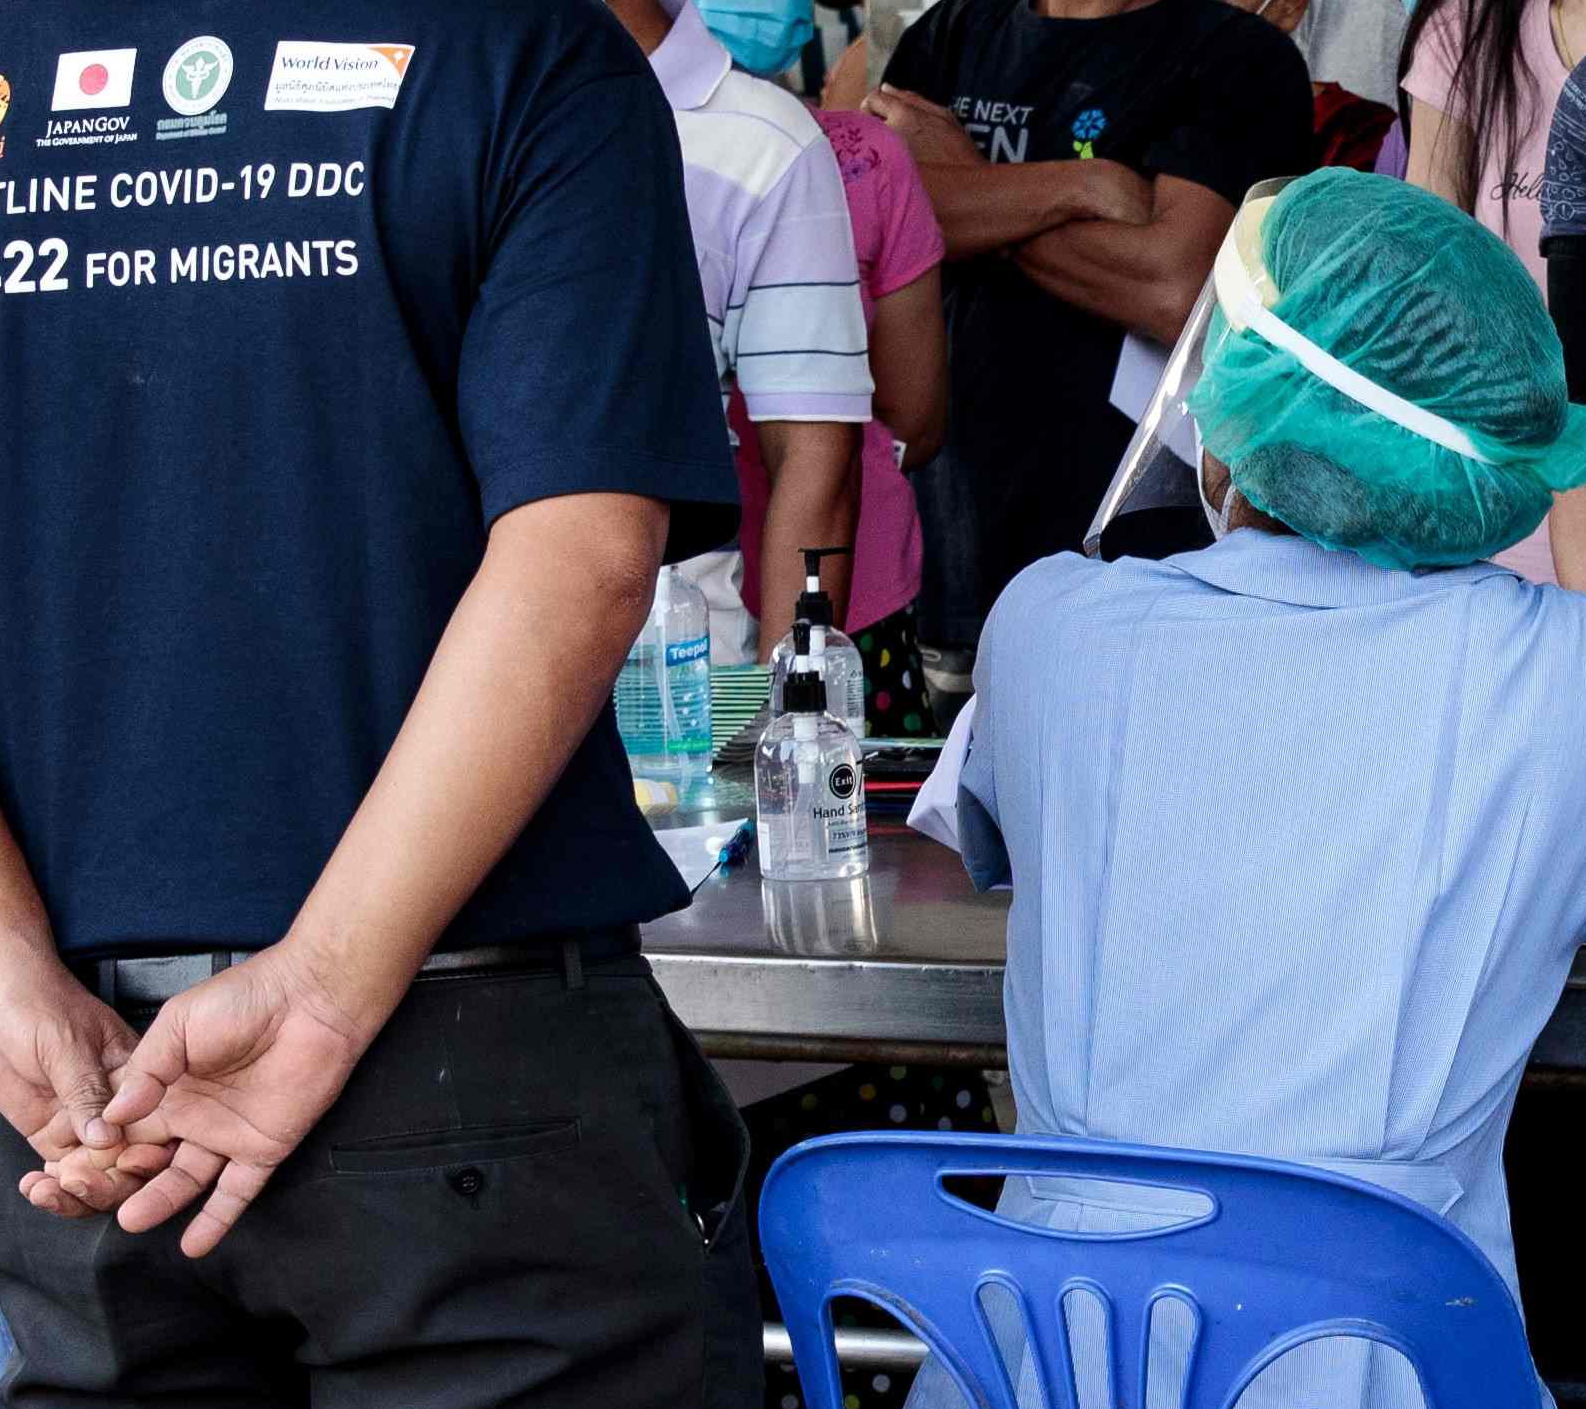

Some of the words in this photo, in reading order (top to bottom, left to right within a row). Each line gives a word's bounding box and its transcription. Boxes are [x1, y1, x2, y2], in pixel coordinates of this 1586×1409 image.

[282, 55, 330, 71] World
[334, 56, 378, 71] Vision
[974, 100, 1034, 125] NEXT
[110, 163, 276, 208] COVID-19
[287, 161, 364, 197] DDC
[86, 250, 156, 288] FOR
[170, 240, 359, 283] MIGRANTS
[814, 805, 845, 819] Hand
